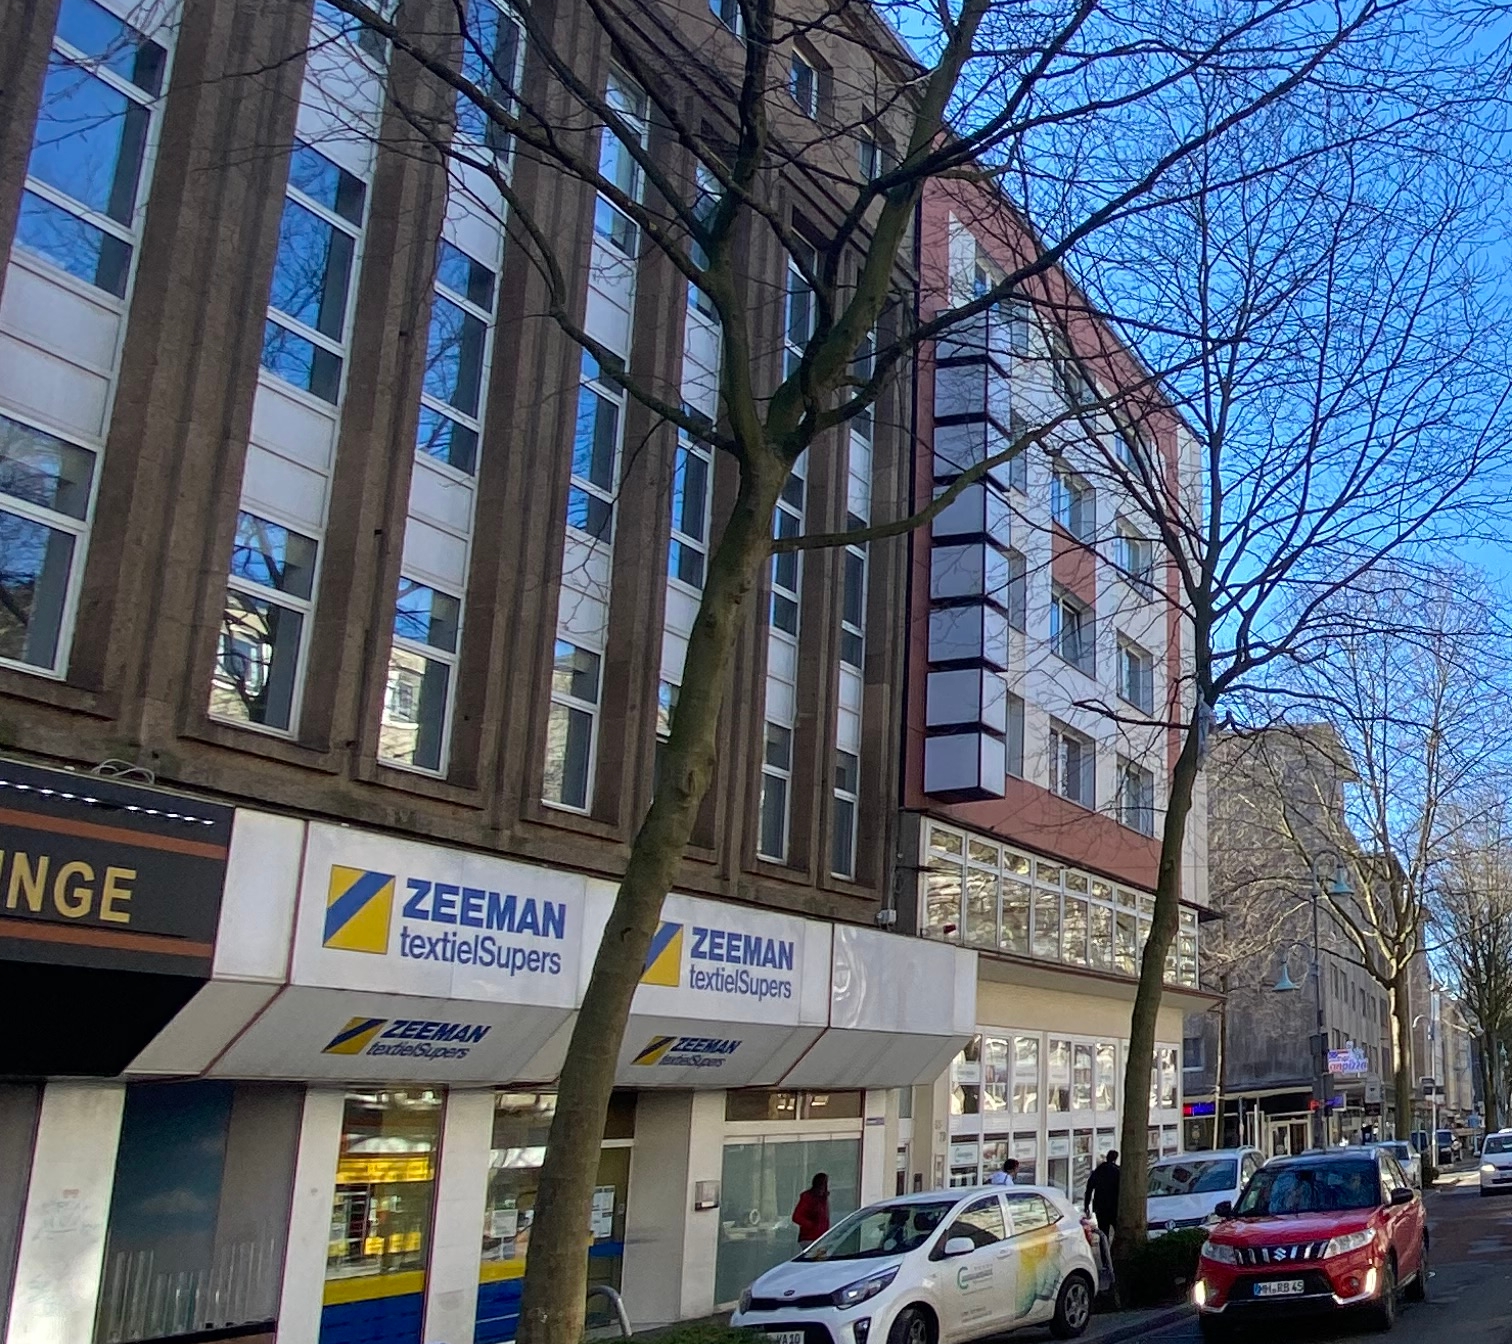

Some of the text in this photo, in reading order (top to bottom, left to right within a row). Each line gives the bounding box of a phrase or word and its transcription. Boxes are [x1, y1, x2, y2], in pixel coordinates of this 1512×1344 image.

[0, 849, 138, 924] NGE
[402, 877, 567, 940] ZEEMAN
[400, 925, 562, 977] textielSupers
[690, 925, 795, 971] ZEEMAN
[690, 963, 792, 1002] textielSupers
[365, 1041, 470, 1061] textielSupers
[380, 1019, 492, 1044] ZEEMAN
[670, 1036, 743, 1055] ZEEMAN
